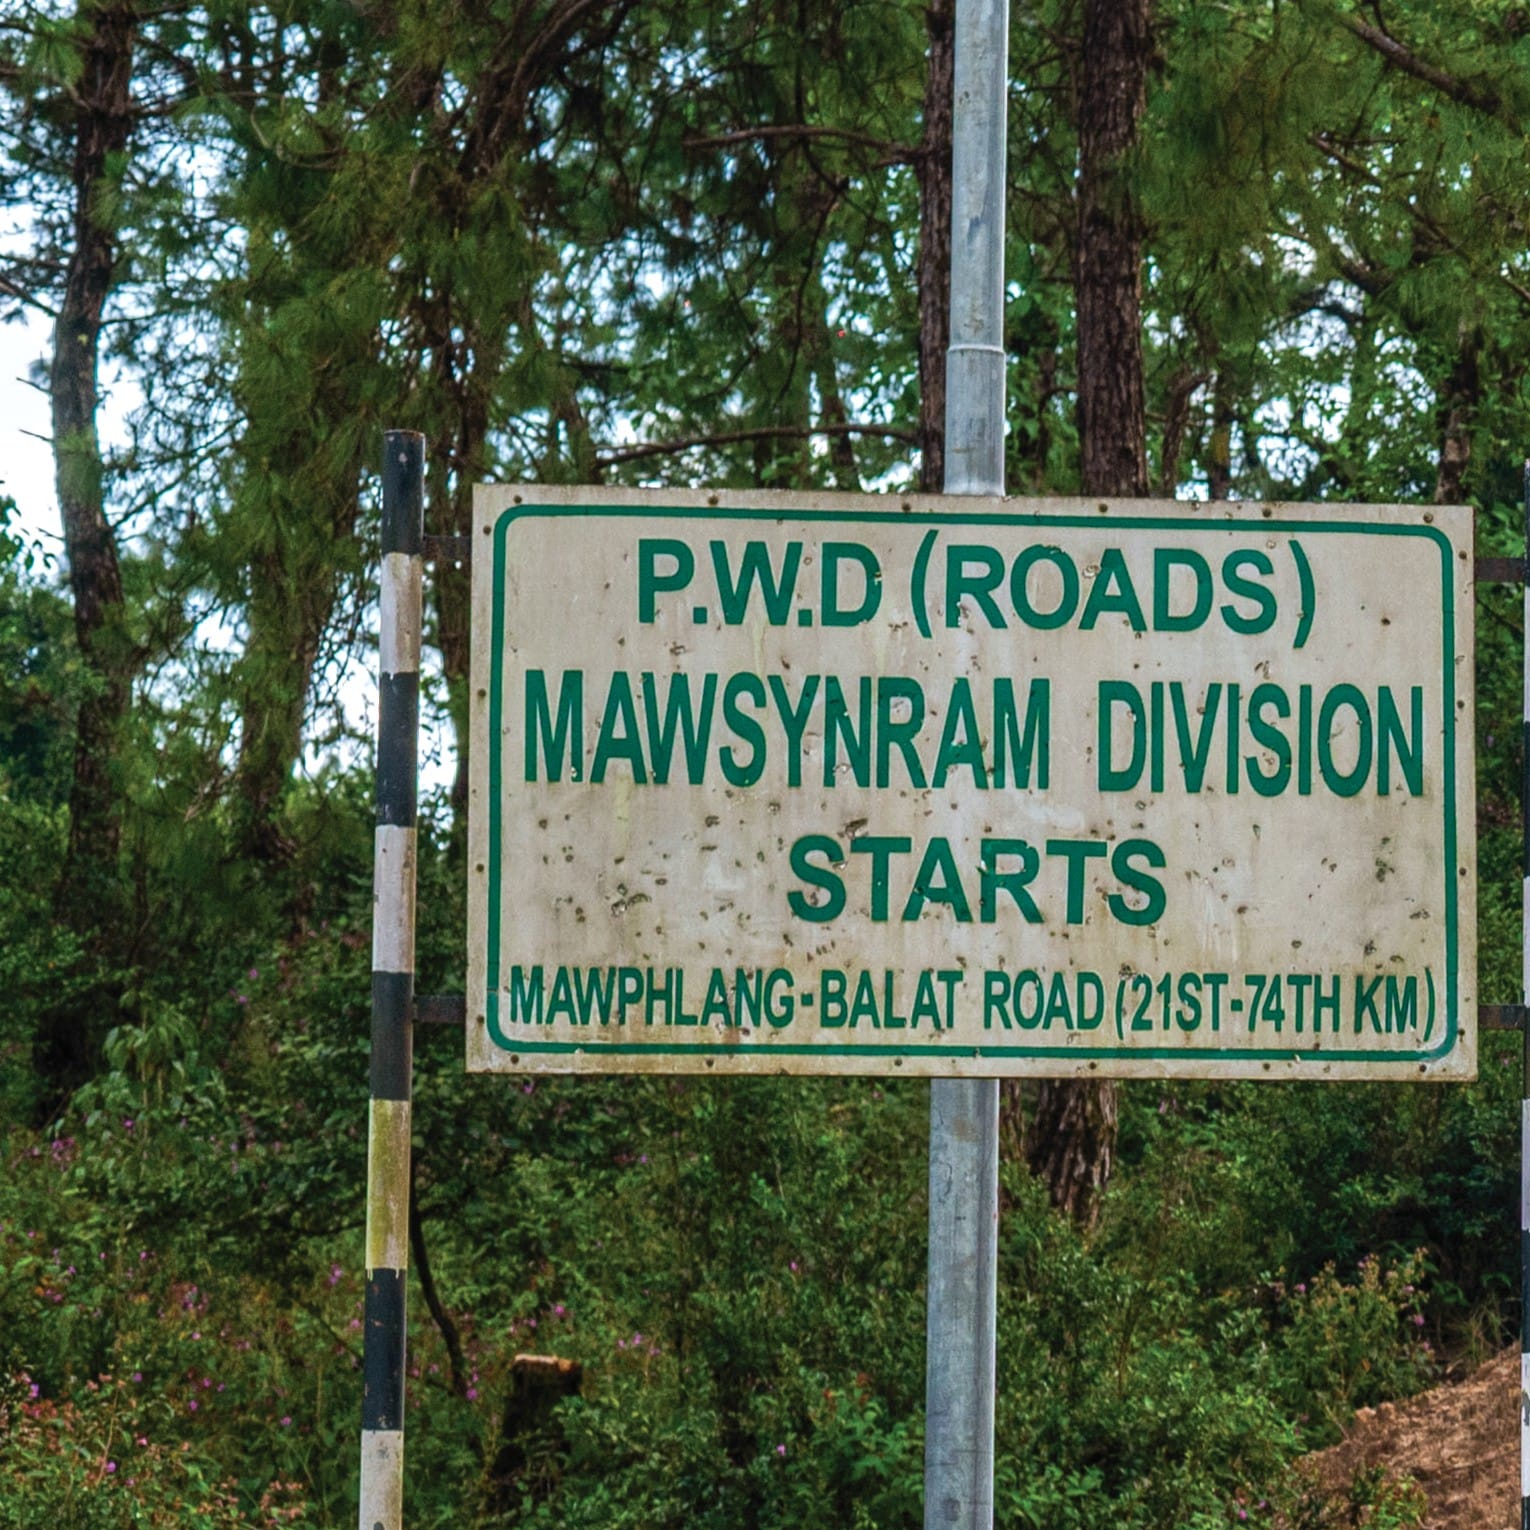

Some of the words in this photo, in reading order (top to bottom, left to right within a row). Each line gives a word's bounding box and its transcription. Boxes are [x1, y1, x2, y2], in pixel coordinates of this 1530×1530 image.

[637, 538, 883, 628] P.W.D
[911, 528, 1317, 649] (ROADS)
[523, 669, 1052, 791] MAWSYNRAM
[1097, 679, 1424, 798] DIVISION
[787, 834, 1168, 927] STARTS
[509, 964, 965, 1030] MAWPHLANG-BALAT
[983, 969, 1105, 1031] ROAD
[1114, 971, 1341, 1041] (21ST-74TH
[1354, 967, 1437, 1042] KM)
